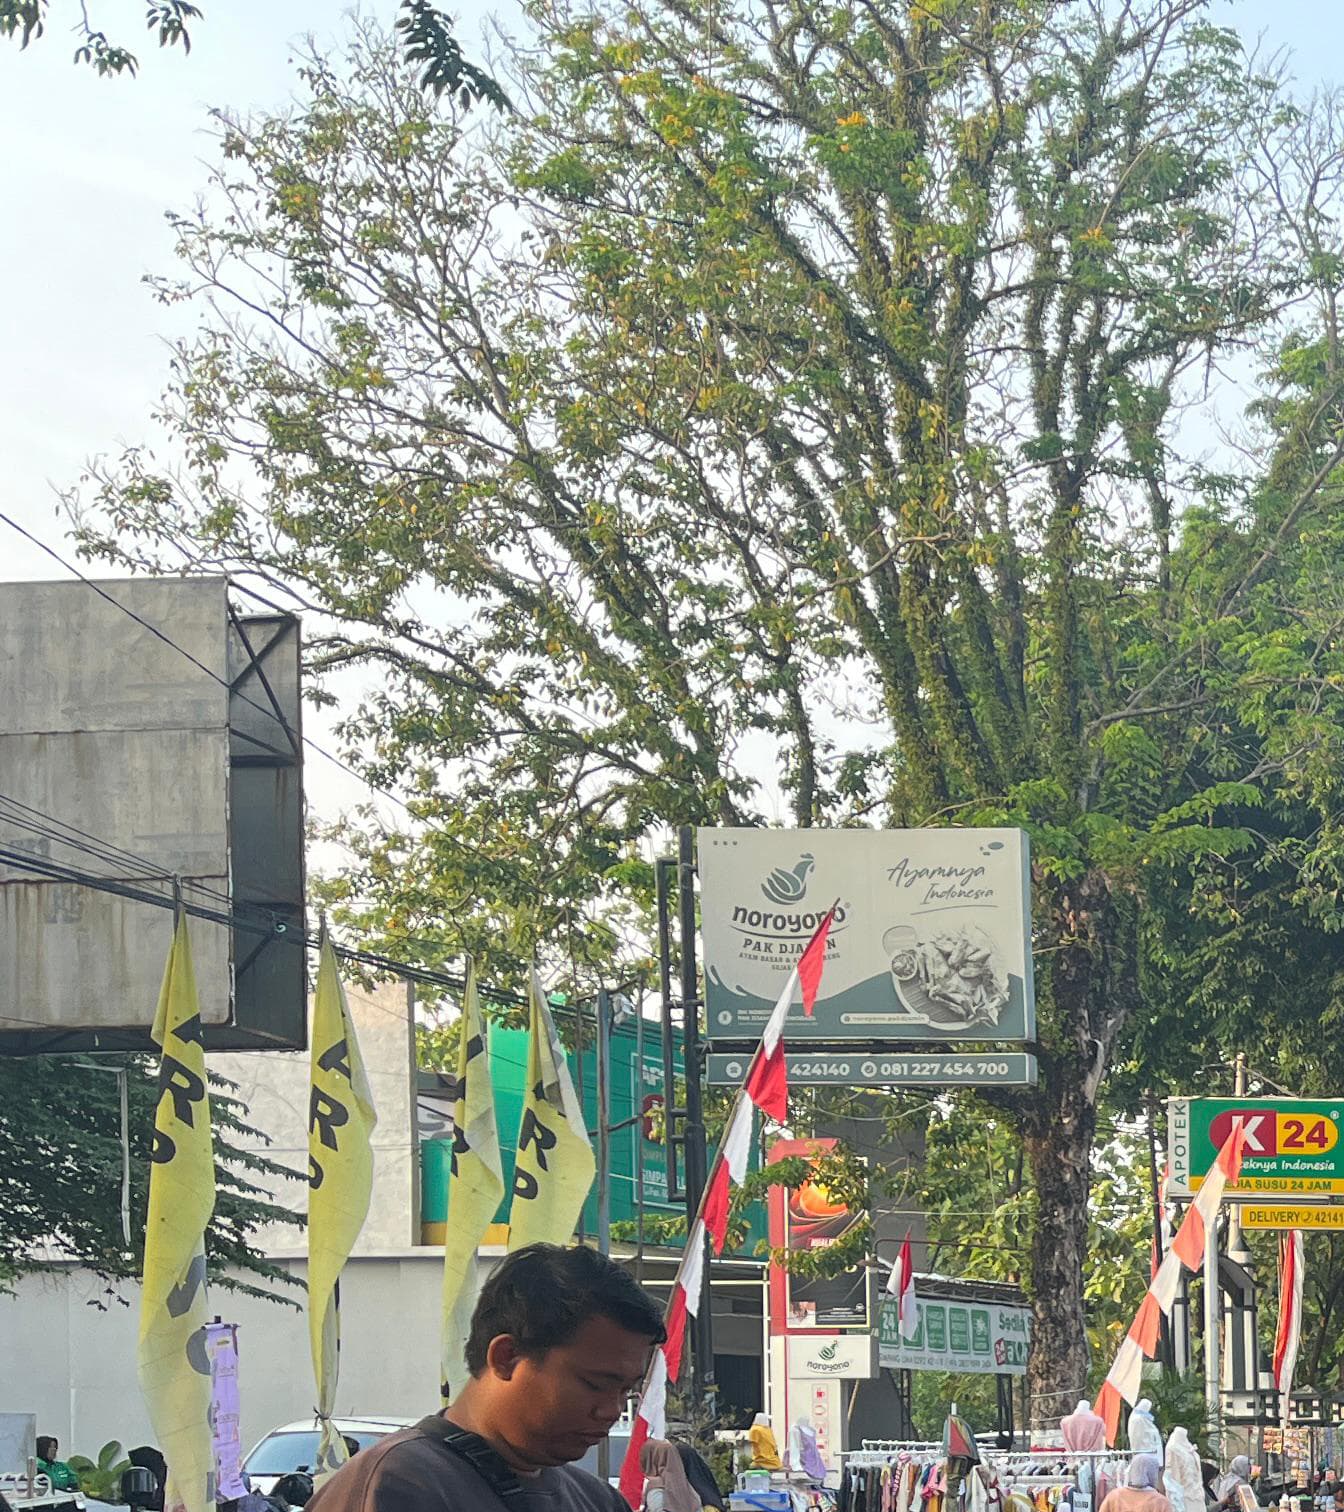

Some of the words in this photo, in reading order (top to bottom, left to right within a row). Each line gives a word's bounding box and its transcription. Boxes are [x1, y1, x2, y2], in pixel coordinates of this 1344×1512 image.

[887, 857, 985, 889] Ayamnya
[920, 882, 994, 905] Indonesia
[743, 938, 773, 954] PAK
[791, 1062, 850, 1076] 424140
[880, 1062, 908, 1076] 081
[911, 1062, 940, 1076] 227
[942, 1062, 974, 1076] 454
[977, 1062, 1009, 1076] 700
[1231, 1115, 1266, 1151] K
[1283, 1120, 1329, 1148] 24
[1174, 1101, 1187, 1186] APOTEK
[1282, 1158, 1335, 1172] Indonesia
[1255, 1179, 1289, 1190] SUSU
[1291, 1179, 1304, 1190] 24
[1308, 1179, 1332, 1190] JAM
[1249, 1210, 1300, 1223] DELIVERY
[806, 1360, 851, 1371] noroyono
